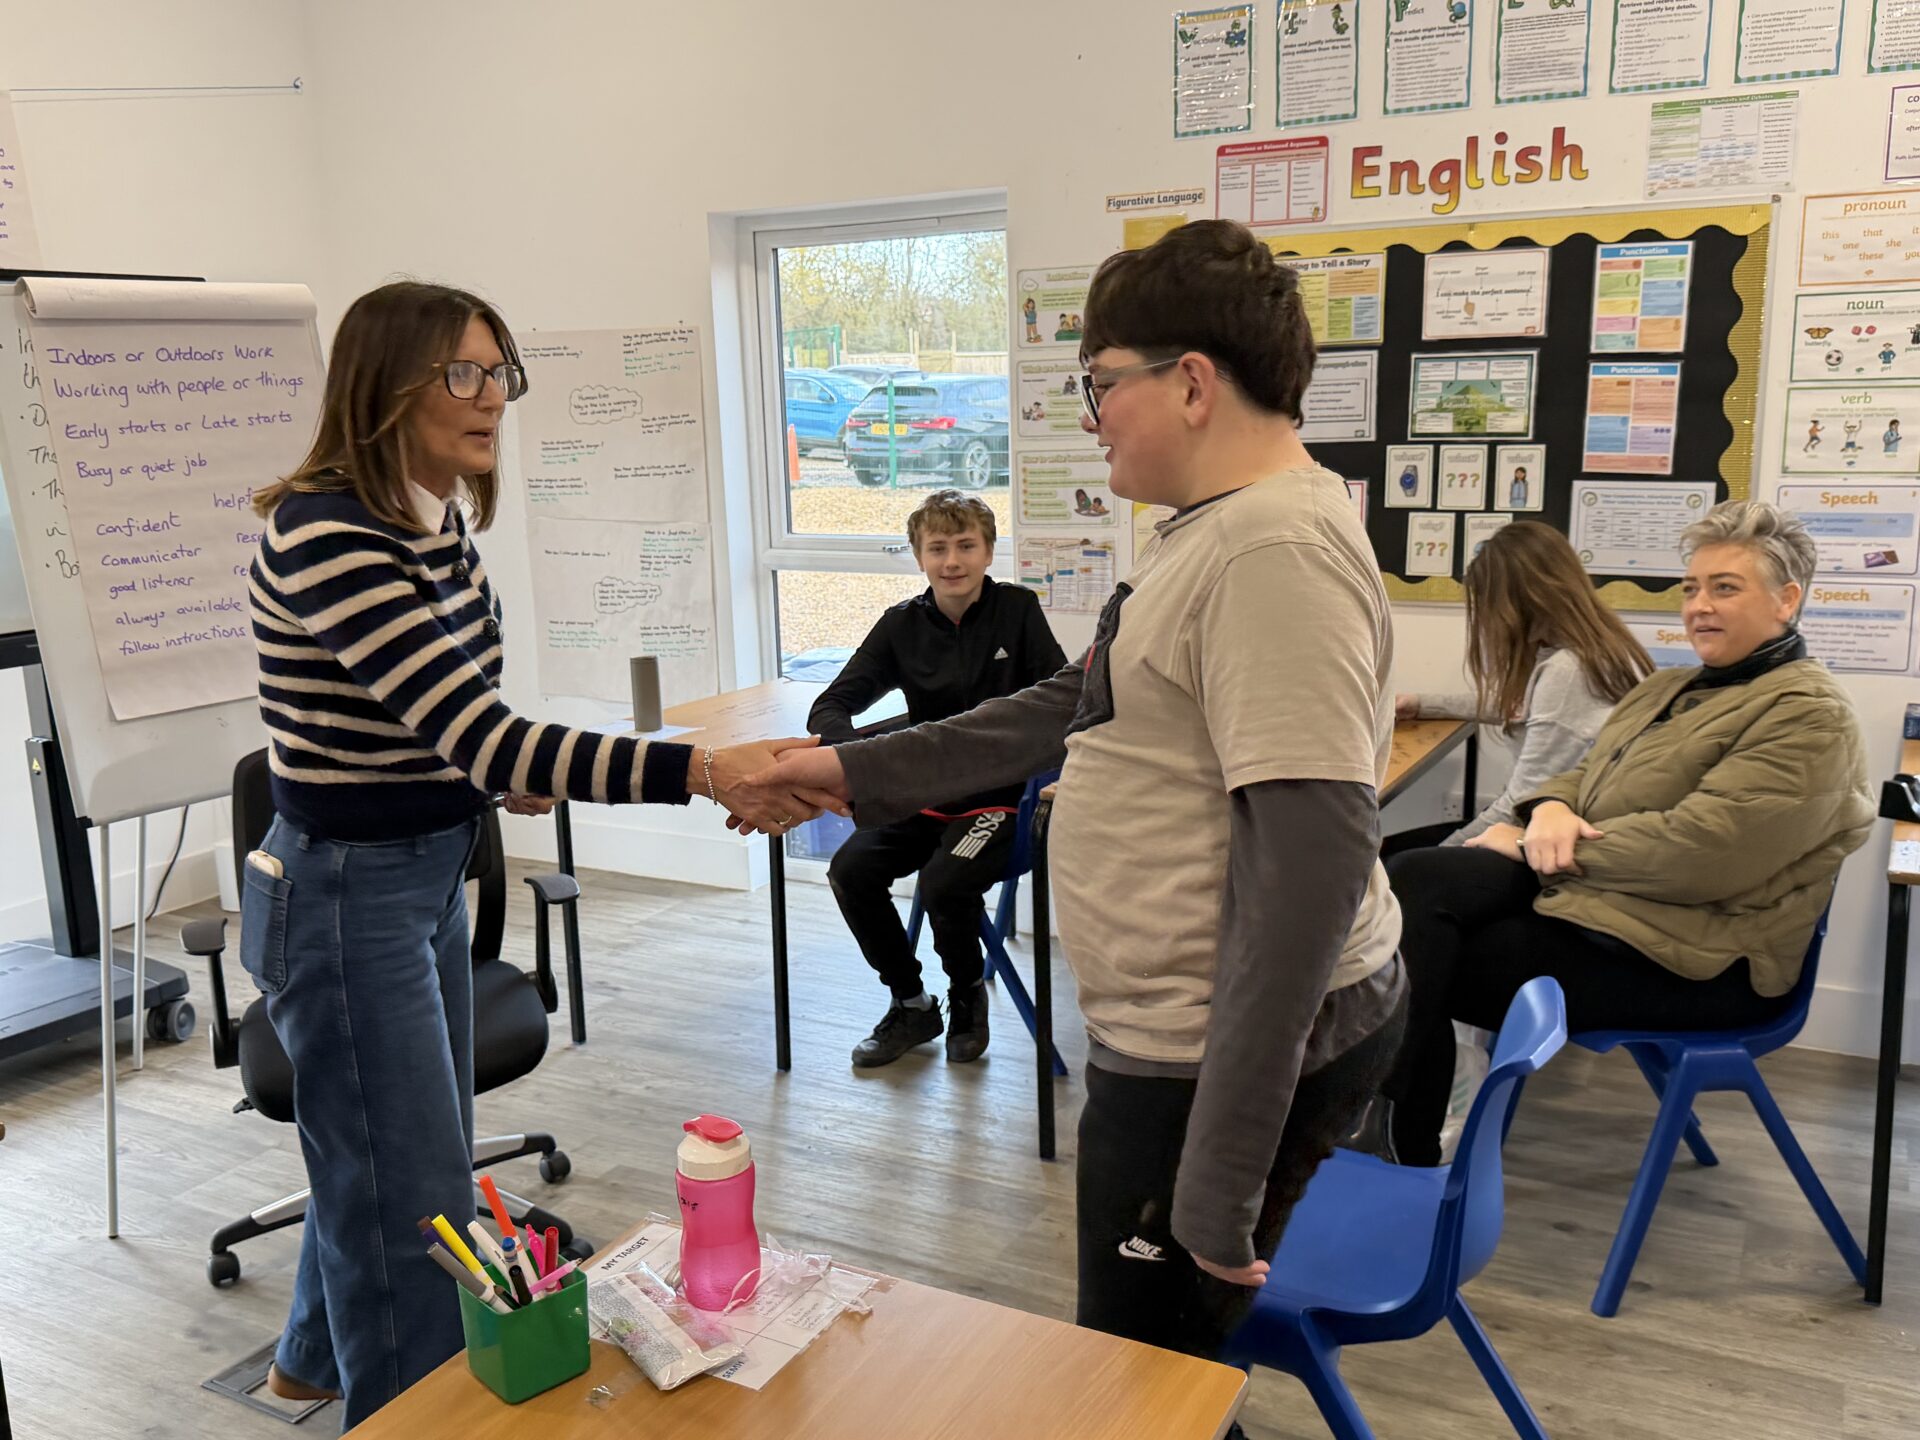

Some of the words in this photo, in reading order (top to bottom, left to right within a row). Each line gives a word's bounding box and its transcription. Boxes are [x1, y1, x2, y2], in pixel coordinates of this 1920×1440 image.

[1350, 126, 1589, 215] English
[1107, 195, 1155, 209] Figurative
[1157, 191, 1203, 206] Language
[1843, 199, 1907, 216] pronoun
[1822, 231, 1840, 240] this
[1863, 228, 1883, 238] that
[1842, 242, 1860, 250] one
[1886, 239, 1902, 248] she
[1310, 262, 1320, 270] to
[1321, 260, 1338, 268] Tell
[1346, 258, 1371, 268] Story
[1823, 253, 1836, 262] he
[1858, 252, 1884, 261] these
[1846, 299, 1884, 310] noun
[46, 348, 117, 366] Indoors
[126, 350, 145, 364] or
[156, 346, 225, 363] Outdoors
[234, 345, 274, 360] Work
[54, 378, 129, 408] Working
[136, 380, 171, 396] with
[178, 380, 225, 401] people
[232, 378, 250, 390] or
[255, 370, 304, 396] things
[1840, 392, 1872, 405] verb
[65, 422, 110, 448] Early
[118, 420, 167, 435] starts
[175, 420, 192, 432] or
[202, 414, 239, 430] Late
[248, 410, 293, 426] starts
[76, 461, 114, 486] Busy
[120, 466, 133, 476] or
[141, 461, 176, 481] quiet
[182, 452, 208, 476] job
[1820, 490, 1879, 508] Speech
[110, 581, 136, 600] good
[143, 574, 196, 590] listener
[1812, 588, 1870, 604] Speech
[115, 611, 166, 628] always
[176, 599, 244, 616] available
[119, 640, 160, 657] follow
[166, 626, 246, 649] instructions
[601, 1258, 619, 1271] MY
[615, 1236, 649, 1259] TARGET
[722, 1360, 745, 1379] SEMH
